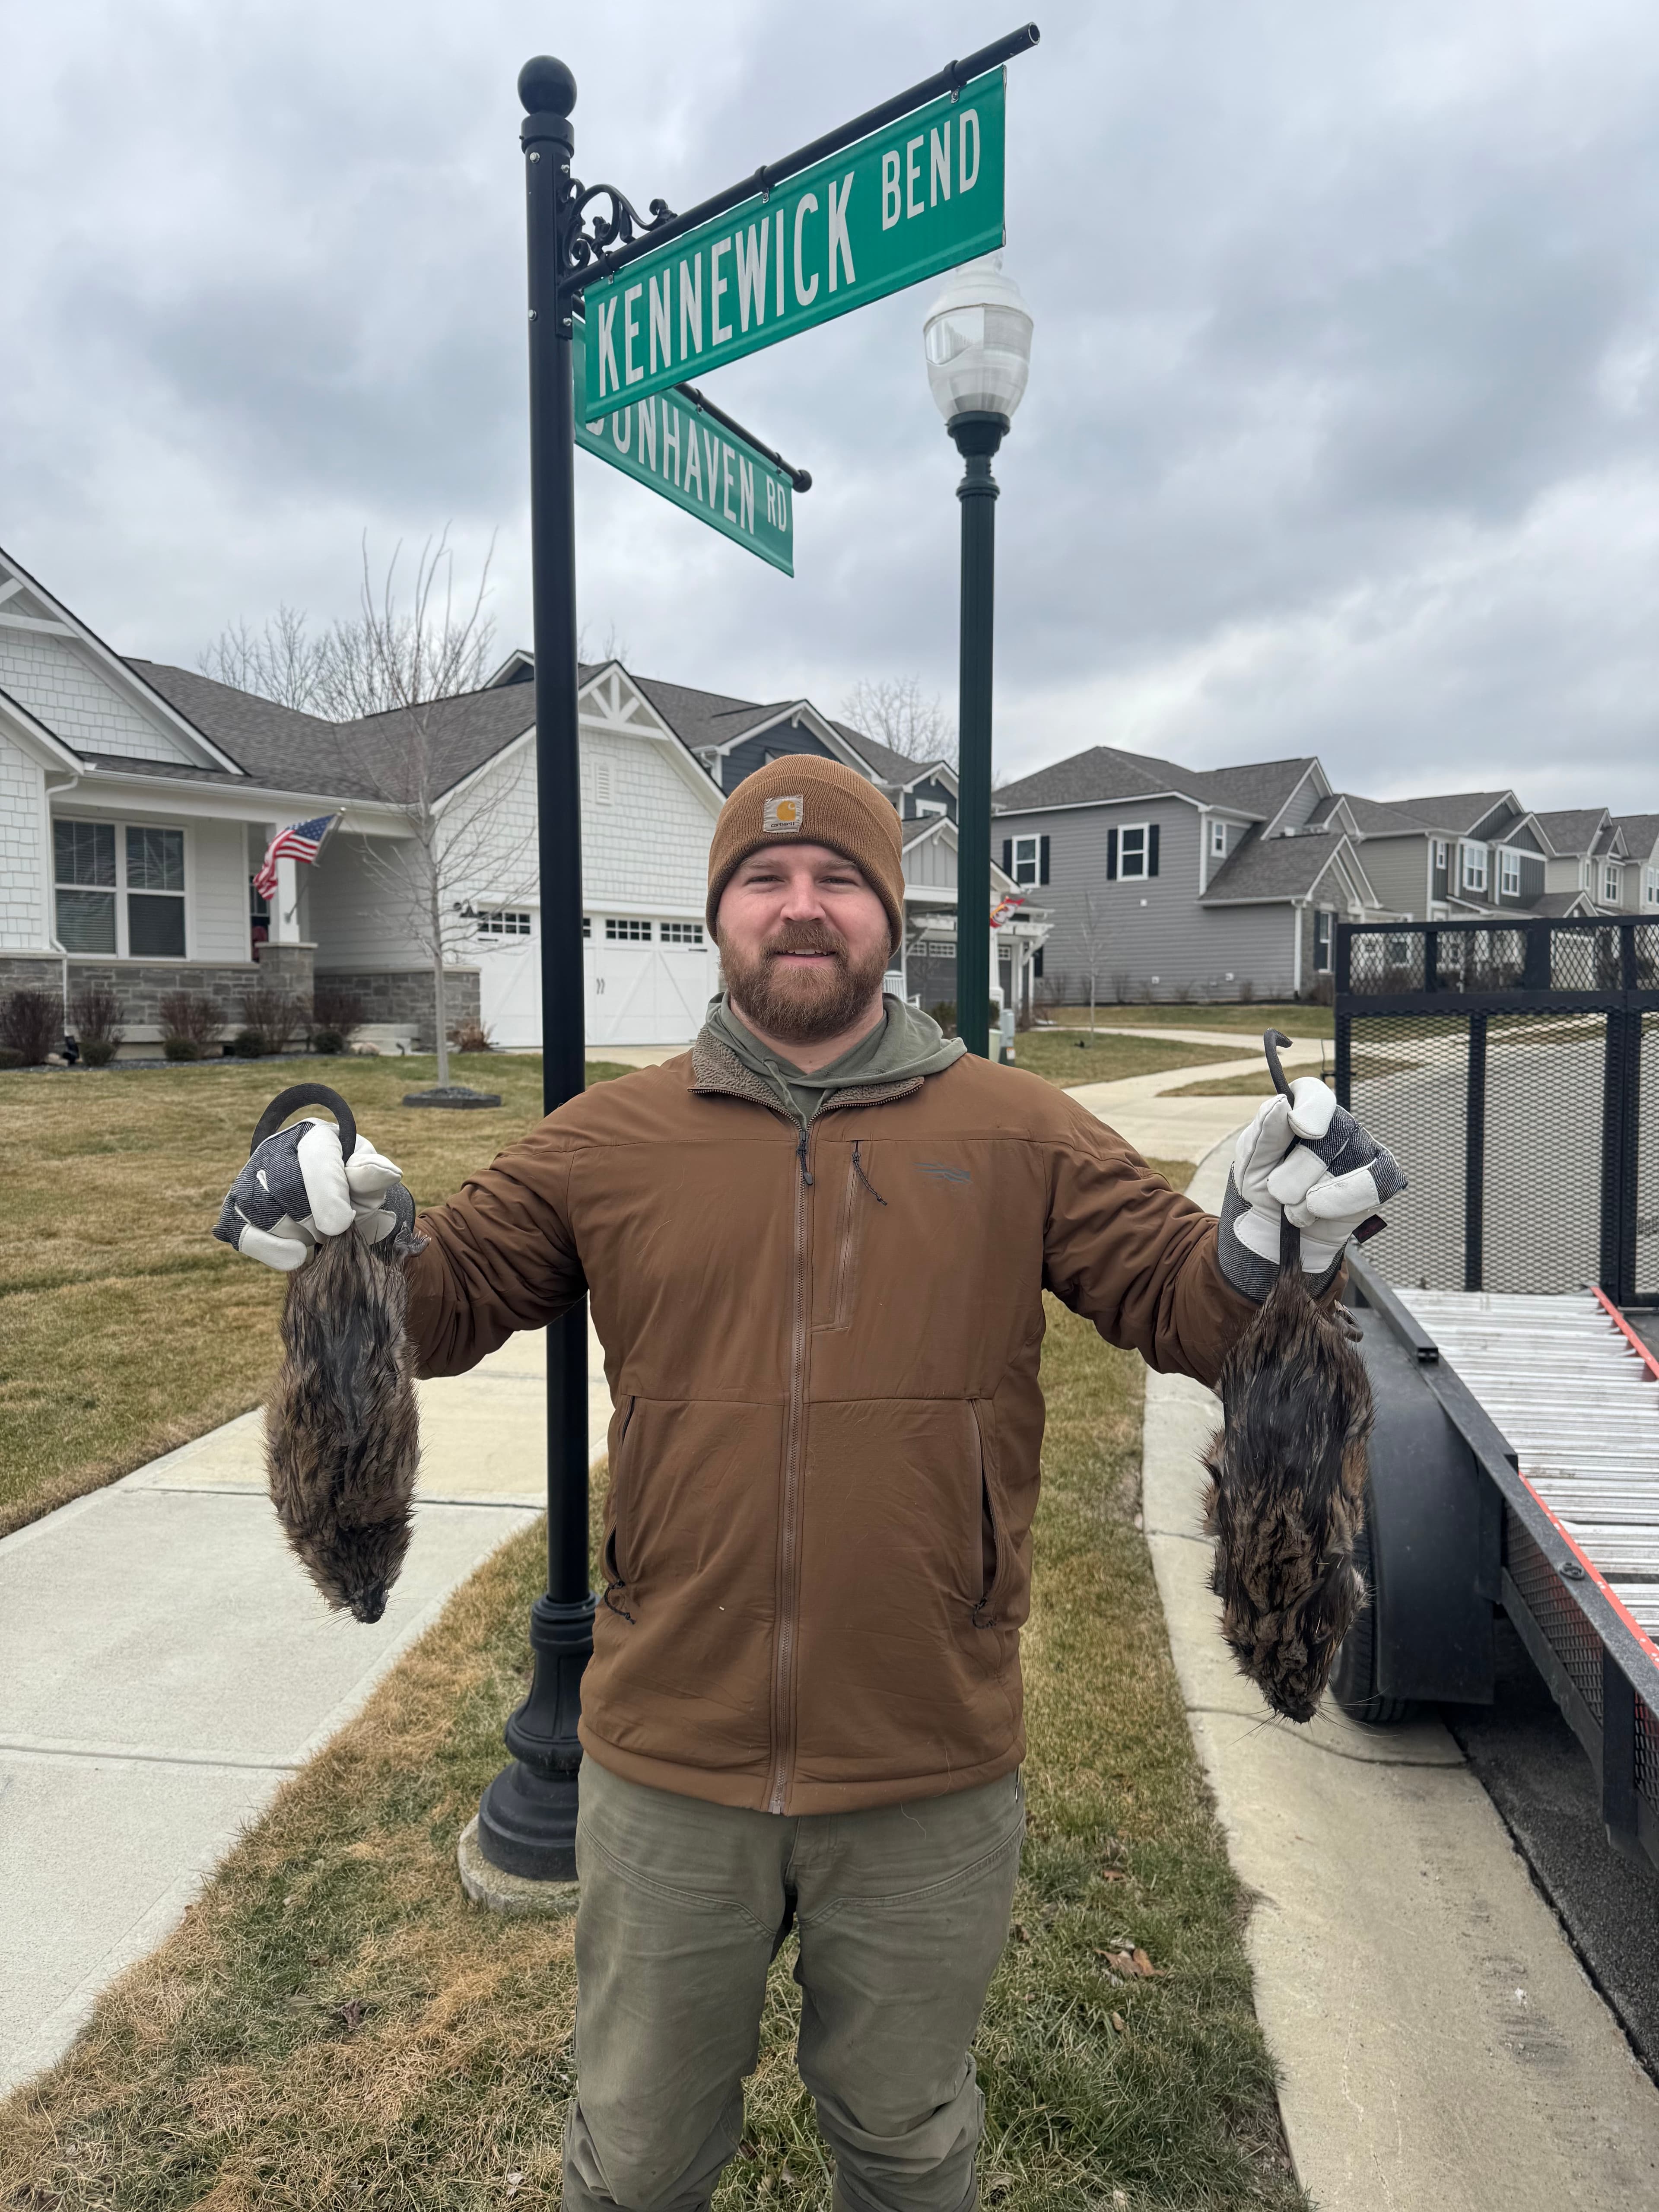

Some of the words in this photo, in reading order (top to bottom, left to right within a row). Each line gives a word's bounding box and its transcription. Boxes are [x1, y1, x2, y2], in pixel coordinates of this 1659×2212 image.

[597, 171, 856, 398] KENNEWICK
[882, 108, 981, 231] BEND
[585, 395, 755, 535] UNHAVEN
[766, 475, 787, 532] RD
